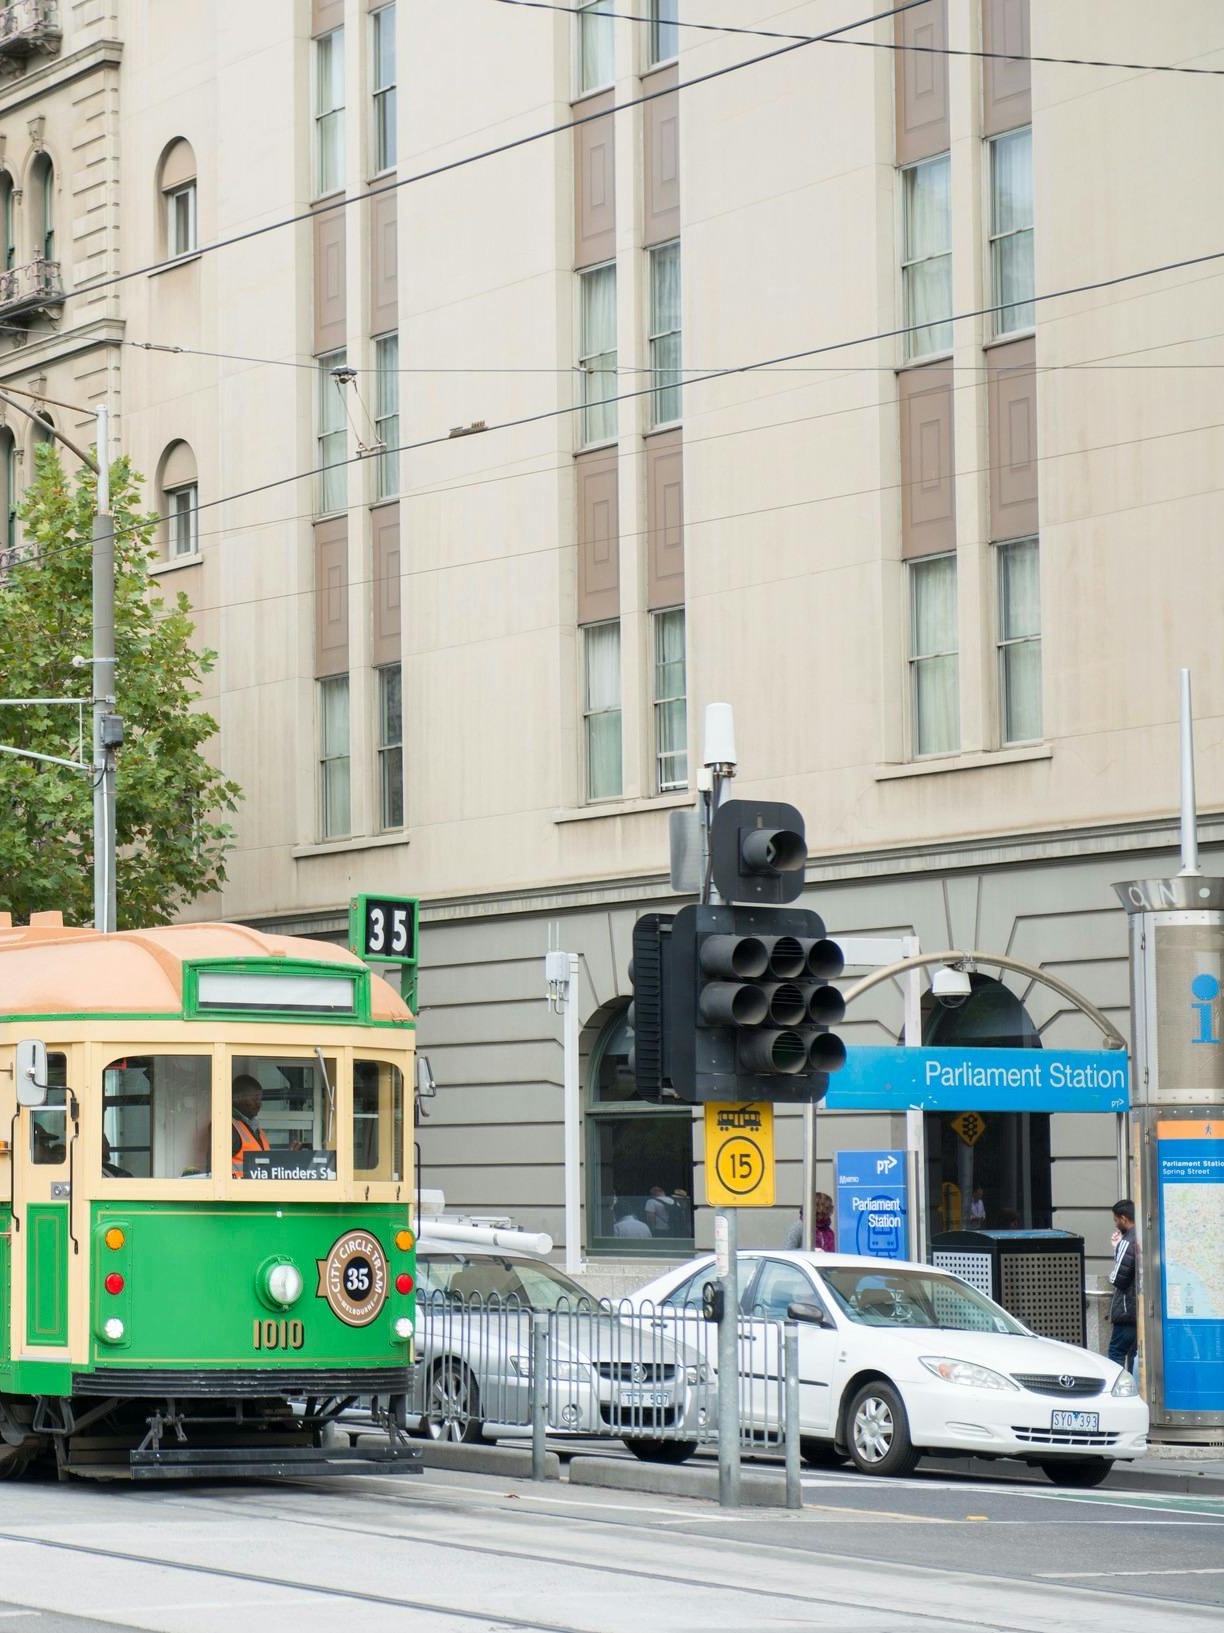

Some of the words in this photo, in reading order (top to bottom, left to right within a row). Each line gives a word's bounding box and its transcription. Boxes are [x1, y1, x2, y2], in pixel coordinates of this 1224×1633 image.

[369, 908, 407, 951] 35
[926, 1061, 1042, 1088] Parliament
[1049, 1062, 1125, 1088] Station
[250, 1167, 268, 1179] via
[271, 1166, 317, 1179] Flinders
[729, 1154, 753, 1179] 15
[852, 1197, 901, 1211] Parliament
[868, 1213, 901, 1228] Station
[331, 1259, 342, 1293] CITY
[339, 1239, 373, 1259] CIRCLE
[371, 1250, 384, 1294] TRAM
[346, 1267, 369, 1291] 35
[253, 1319, 304, 1349] 1010
[1079, 1415, 1097, 1428] 393
